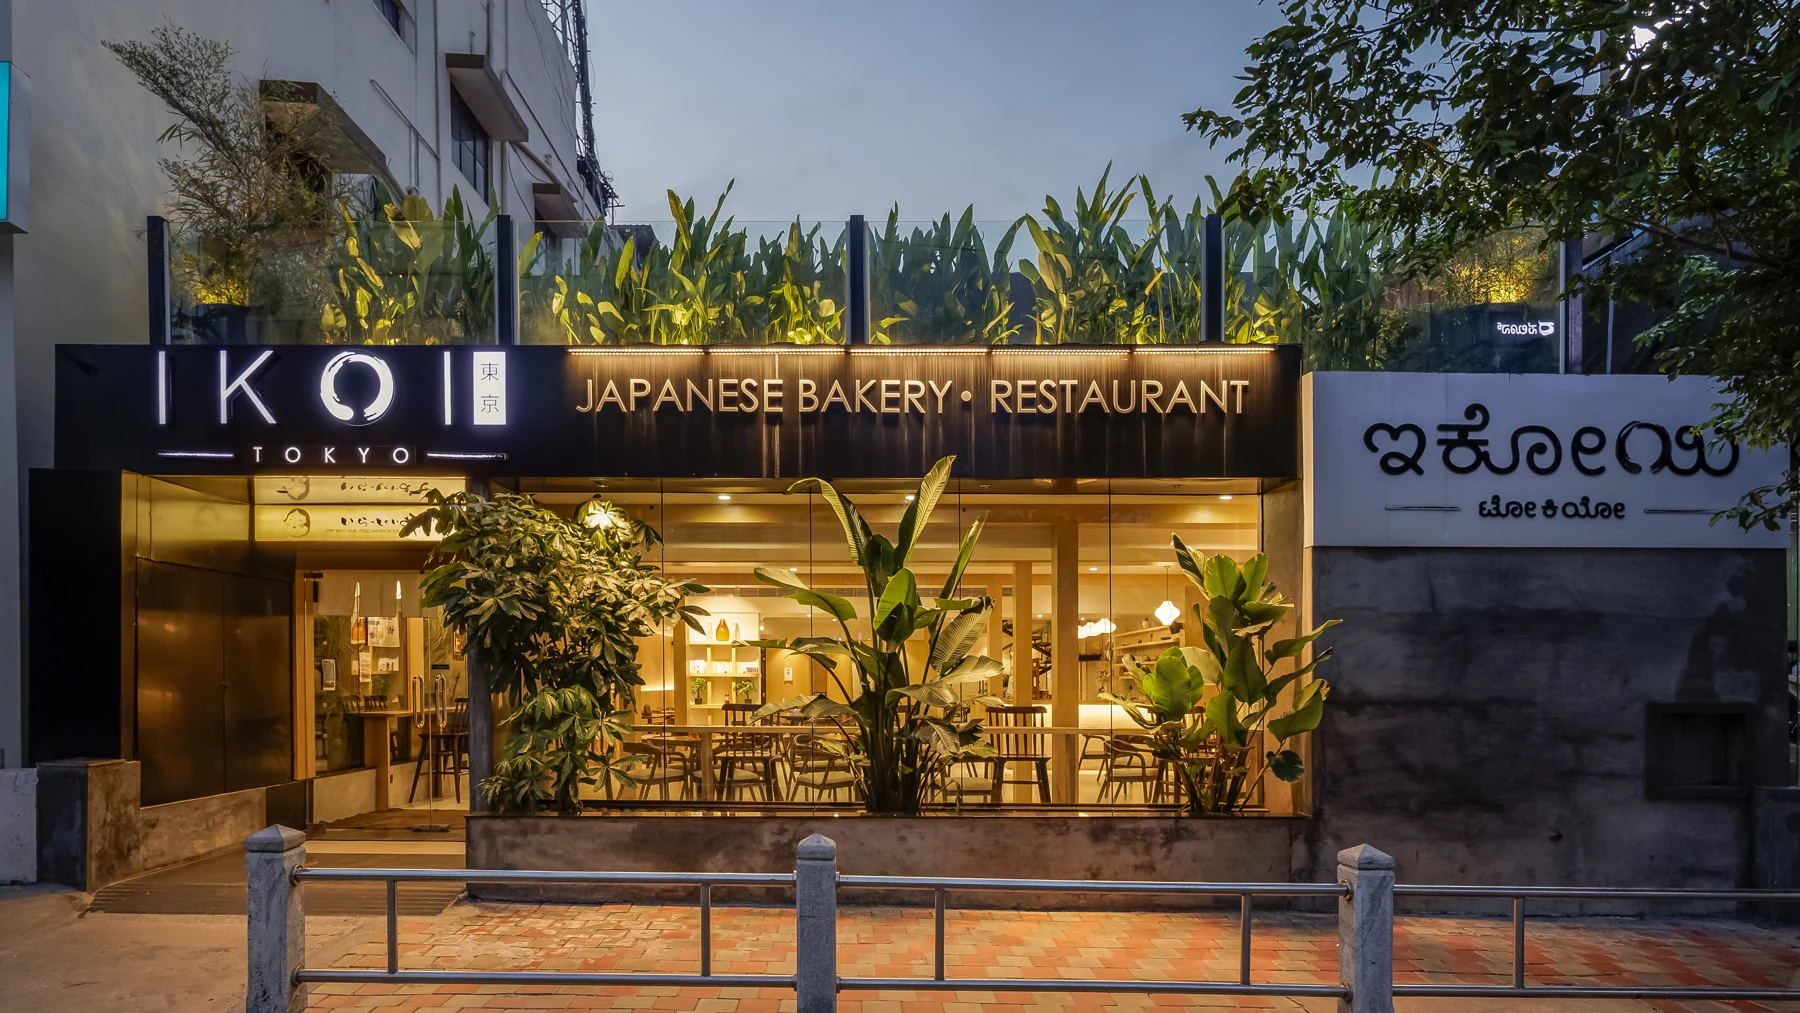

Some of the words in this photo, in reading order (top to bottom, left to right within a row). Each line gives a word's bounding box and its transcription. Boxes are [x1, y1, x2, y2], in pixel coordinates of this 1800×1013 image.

[157, 349, 452, 426] IKOI
[480, 361, 500, 414] 東京
[575, 378, 784, 413] JAPANESE
[798, 378, 953, 414] BAKERY
[990, 379, 1249, 414] RESTAURANT
[253, 446, 410, 464] TOKYO
